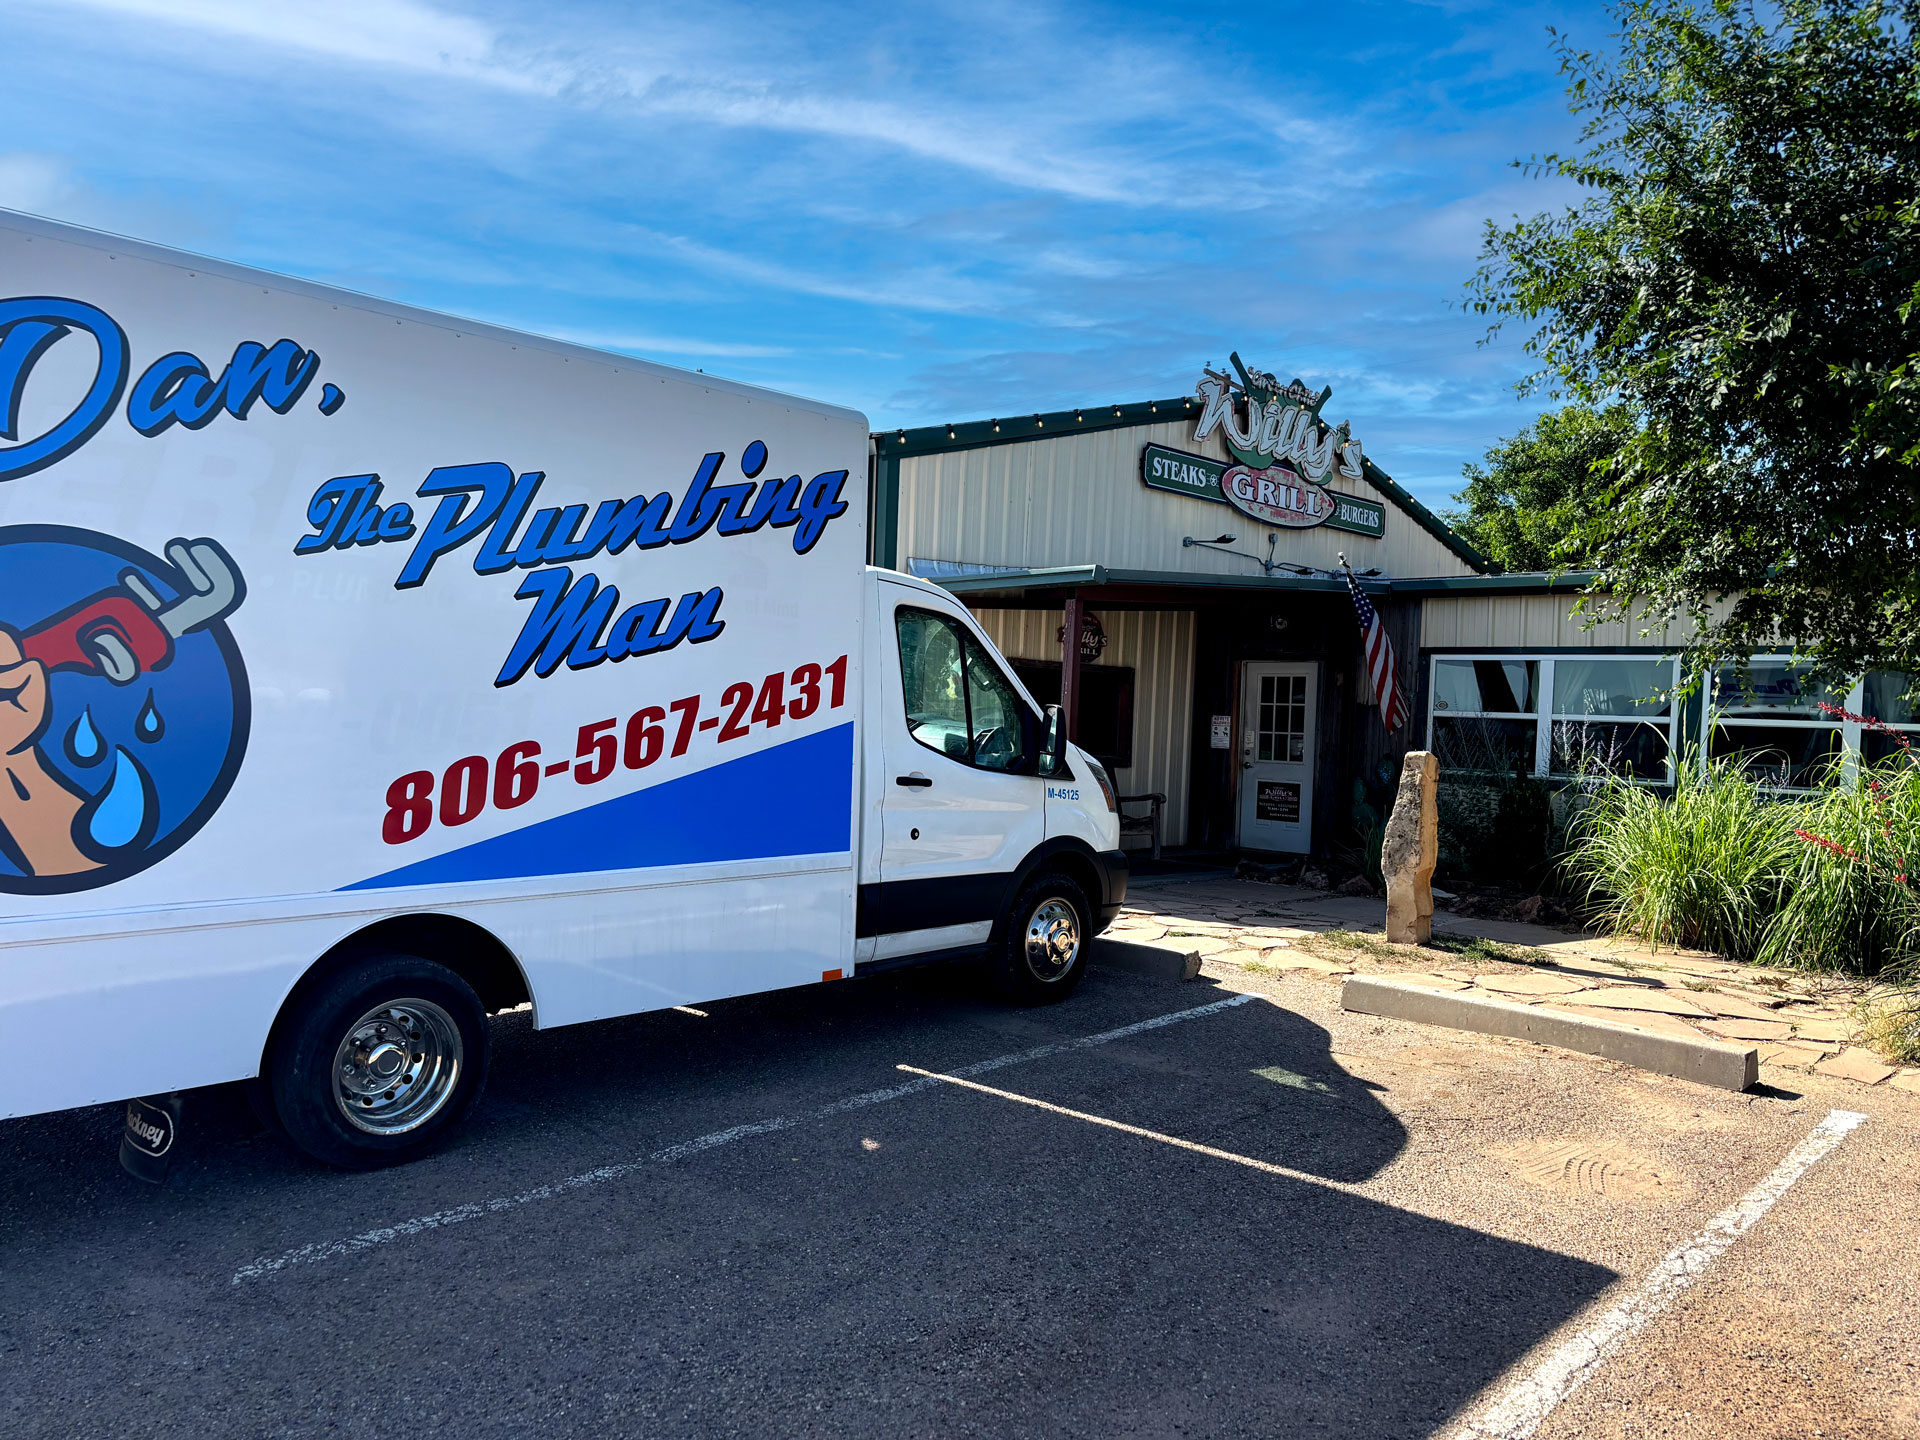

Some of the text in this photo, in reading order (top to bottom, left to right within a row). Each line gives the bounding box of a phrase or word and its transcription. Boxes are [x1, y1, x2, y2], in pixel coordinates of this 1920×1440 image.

[1192, 377, 1364, 482] Willy's
[1152, 456, 1206, 488] STEAKS
[1230, 472, 1325, 518] GRILL
[293, 472, 417, 556] The
[395, 440, 850, 590] Plumbing
[1340, 504, 1379, 528] BURGERS
[494, 565, 726, 688] Man
[381, 654, 849, 845] 806-567-2431
[1047, 787, 1080, 801] M-45125
